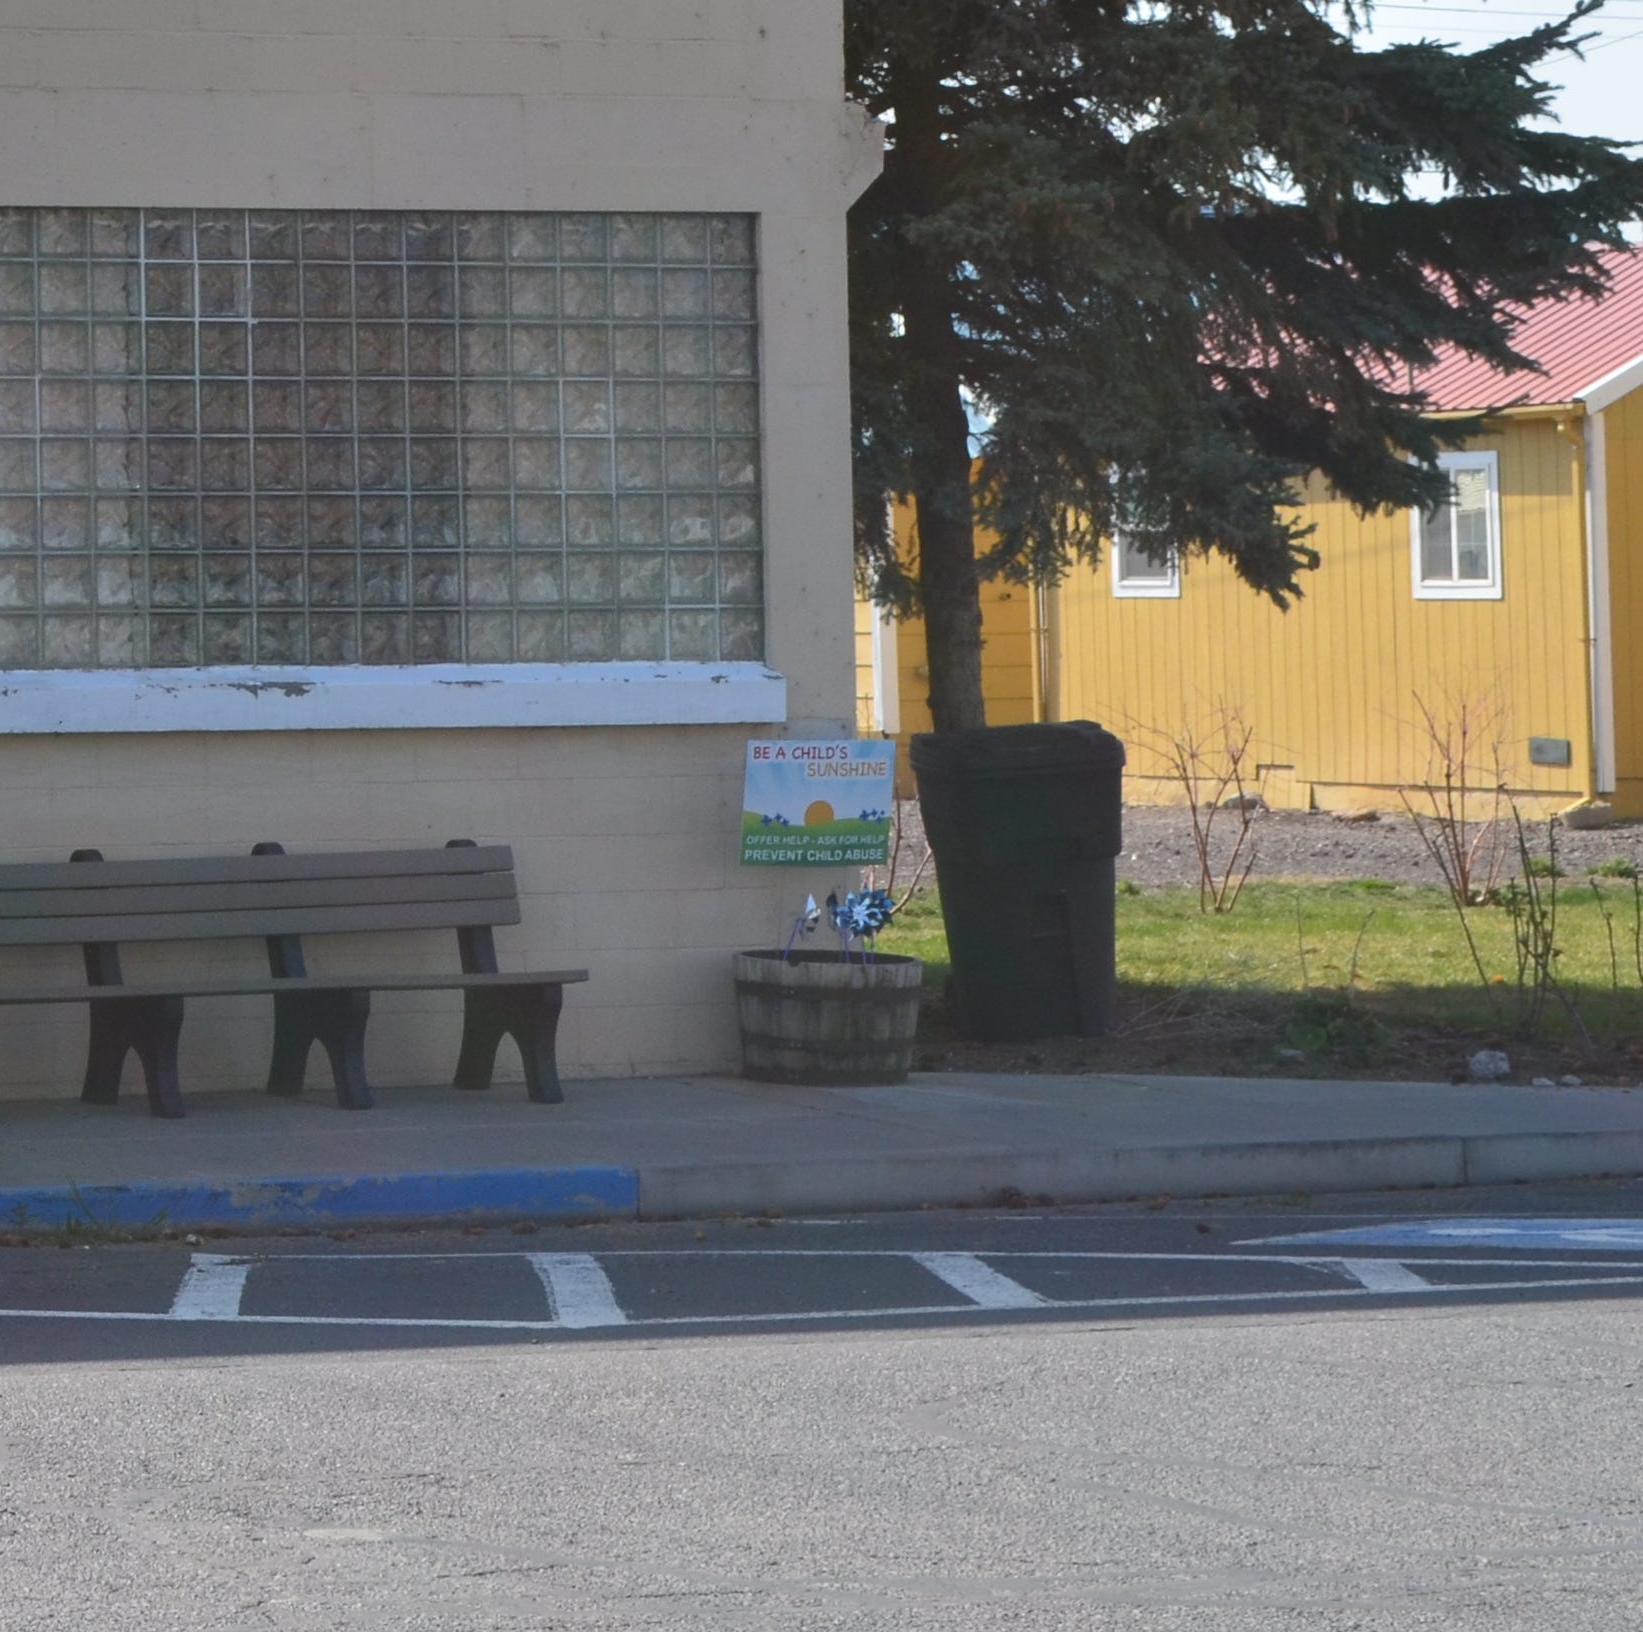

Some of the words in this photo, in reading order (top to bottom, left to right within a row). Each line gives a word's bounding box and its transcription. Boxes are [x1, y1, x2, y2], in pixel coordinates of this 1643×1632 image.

[752, 746, 771, 759] BE
[775, 746, 787, 759] A
[791, 745, 849, 760] CHILD'S
[807, 761, 887, 777] SUNSHINE
[746, 835, 780, 846] OFFER
[783, 835, 811, 846] HELP
[817, 835, 837, 846] ASK
[839, 835, 859, 845] FOR
[860, 834, 885, 845] HELP
[744, 849, 804, 862] PREVENT
[806, 849, 843, 862] CHILD
[844, 848, 884, 861] ABUSE
